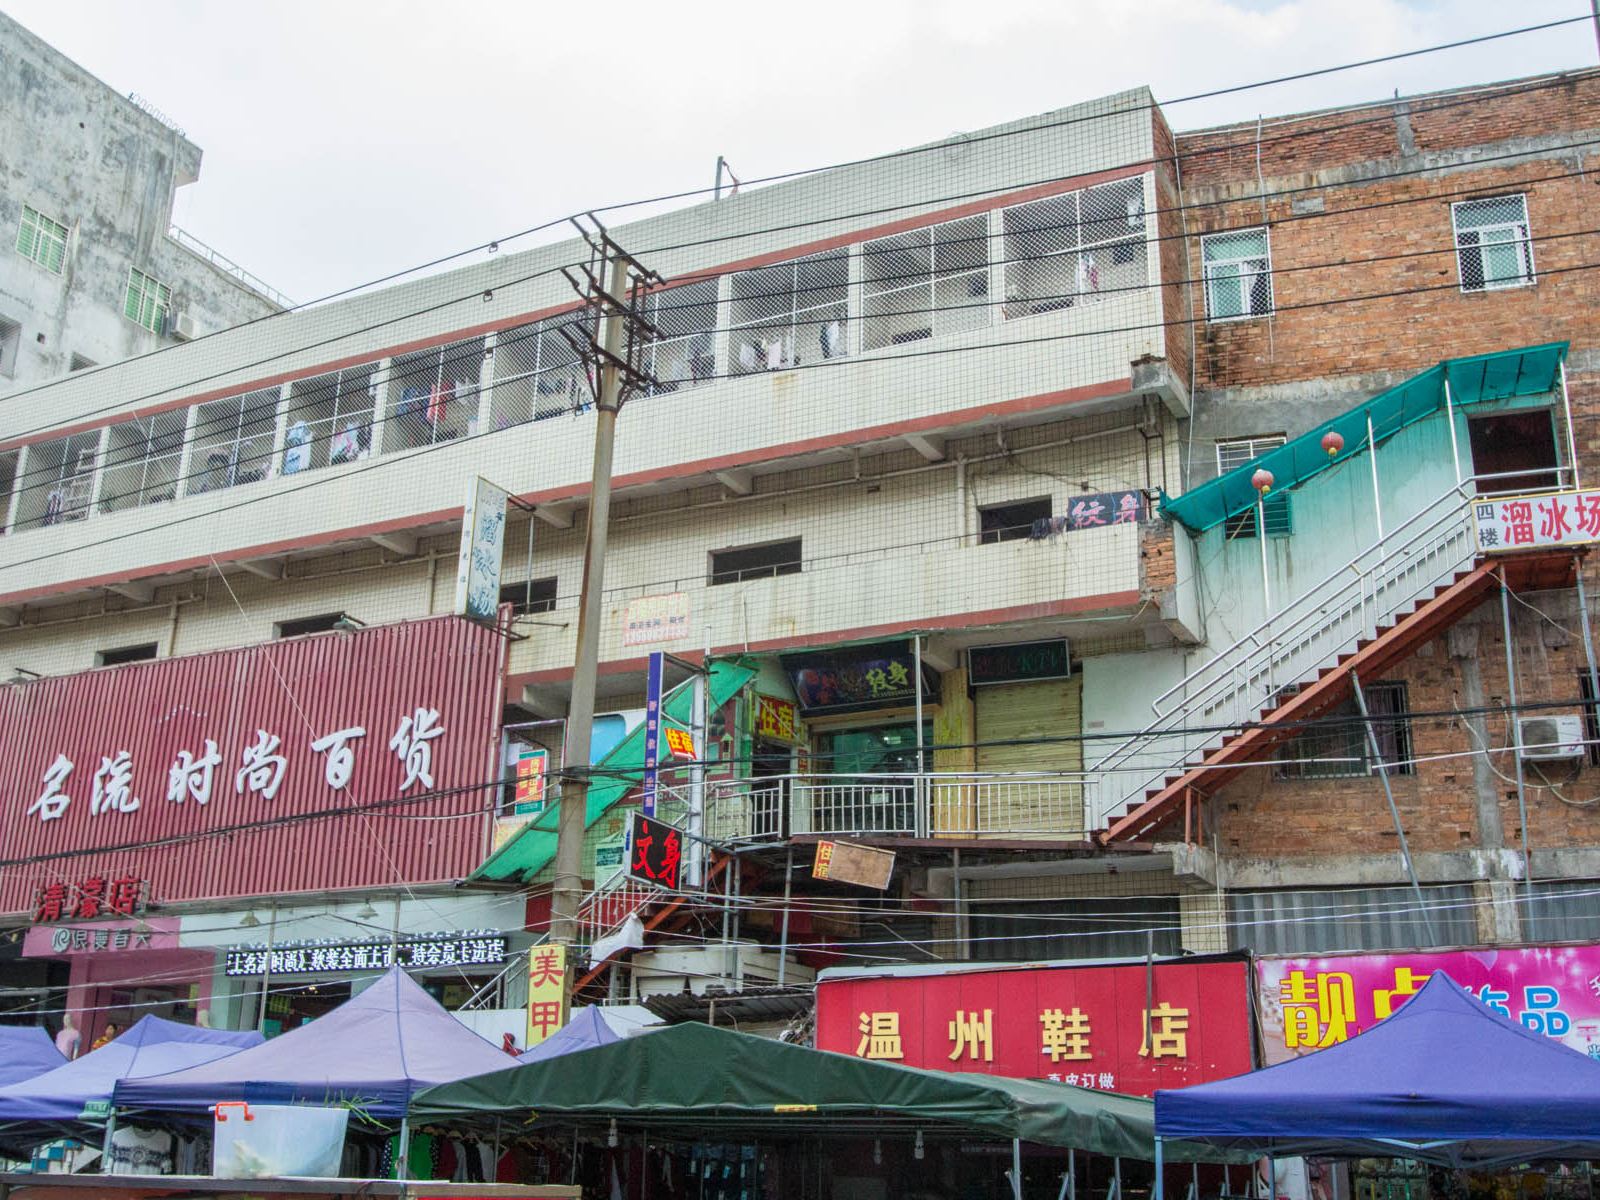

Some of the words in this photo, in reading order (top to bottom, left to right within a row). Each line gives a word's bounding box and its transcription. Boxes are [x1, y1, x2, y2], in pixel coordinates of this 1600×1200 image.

[1072, 494, 1139, 528] 纹身
[1476, 504, 1498, 546] 四楼
[1501, 495, 1600, 544] 溜冰场
[666, 727, 694, 753] 住宿
[759, 701, 796, 738] 住宿
[27, 707, 445, 822] 名流时尚百货
[632, 819, 681, 889] 文身
[530, 948, 564, 1038] 美甲
[856, 1002, 1188, 1062] 温州鞋店
